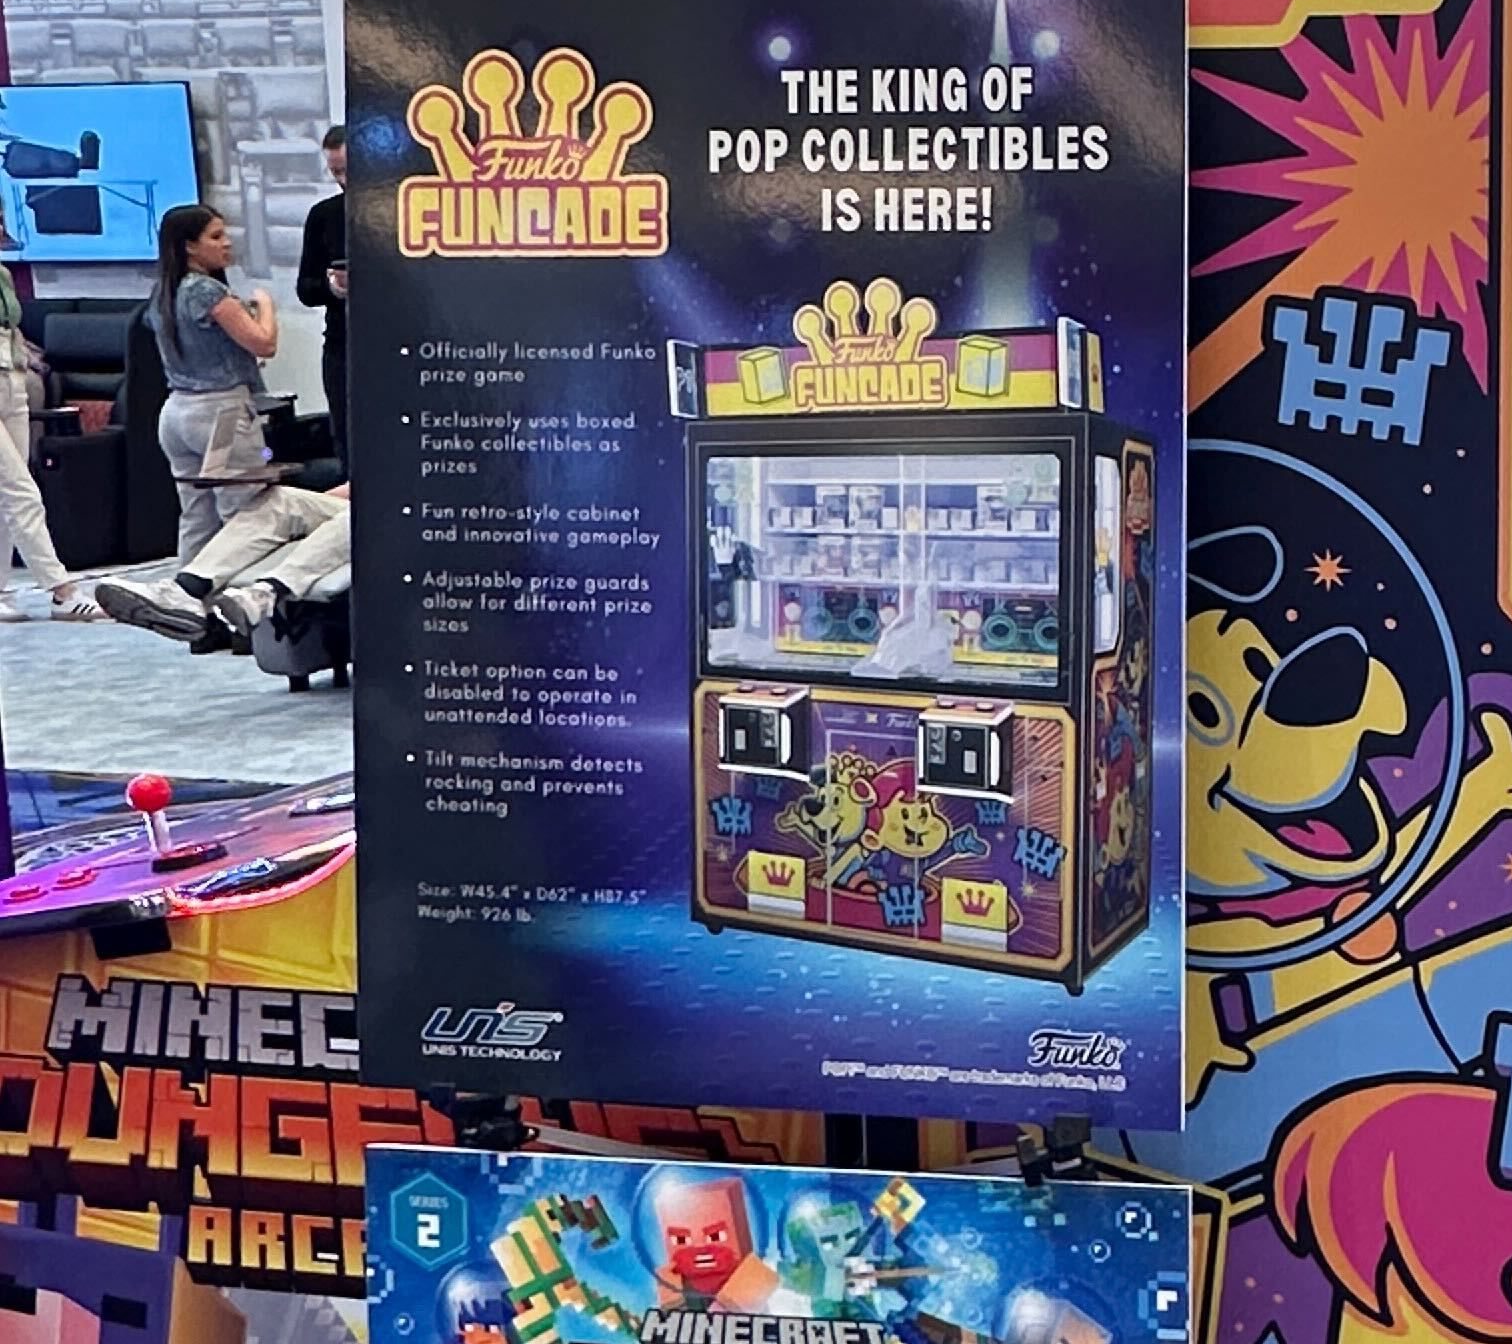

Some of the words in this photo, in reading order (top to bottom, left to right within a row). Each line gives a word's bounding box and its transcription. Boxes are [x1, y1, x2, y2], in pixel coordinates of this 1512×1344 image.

[781, 68, 858, 114] THE
[872, 67, 968, 113] KING
[982, 66, 1033, 112] OF
[473, 136, 583, 182] Funko
[709, 128, 787, 173] POP
[802, 125, 1110, 173] COLLECTIBLES
[409, 186, 662, 246] FUNCADE
[822, 187, 862, 233] IS
[874, 186, 994, 233] HERE!
[419, 342, 507, 363] Officially
[515, 341, 593, 360] licensed
[601, 343, 656, 360] Funko
[420, 366, 466, 386] prize
[474, 369, 525, 387] game
[796, 364, 944, 404] FUNCADE
[421, 412, 521, 433] Exclusively
[528, 415, 569, 430] uses
[576, 412, 635, 430] boxed
[421, 435, 474, 451] Funko
[481, 435, 592, 453] collectibles
[599, 439, 620, 453] as
[421, 458, 477, 476] prizes
[422, 504, 454, 519] Fun
[462, 505, 560, 525] retro-style
[567, 505, 640, 522] cabinet
[422, 524, 457, 542] and
[464, 526, 560, 544] innovative
[567, 527, 661, 549] gameplay
[422, 571, 522, 591] Adjustable
[530, 574, 577, 594] prize
[585, 574, 649, 594] guards
[423, 593, 472, 610] allow
[481, 594, 506, 610] for
[514, 594, 596, 612] different
[604, 597, 652, 617] prize
[423, 616, 469, 633] sizes
[424, 661, 479, 678] Ticket
[486, 663, 546, 684] option
[552, 666, 588, 681] can
[595, 664, 618, 681] be
[424, 683, 504, 702] disabled
[512, 685, 529, 702] to
[538, 687, 612, 708] operate
[620, 687, 637, 704] in
[424, 708, 532, 725] unattended
[425, 751, 454, 767] Tilt
[461, 752, 564, 770] mechanism
[571, 755, 643, 773] detects
[425, 775, 493, 795] rocking
[501, 776, 535, 793] and
[542, 779, 624, 797] prevents
[425, 798, 508, 818] cheating
[461, 1045, 562, 1062] TECHNOLOGY
[1027, 1029, 1126, 1069] Funko
[416, 1213, 441, 1248] 2
